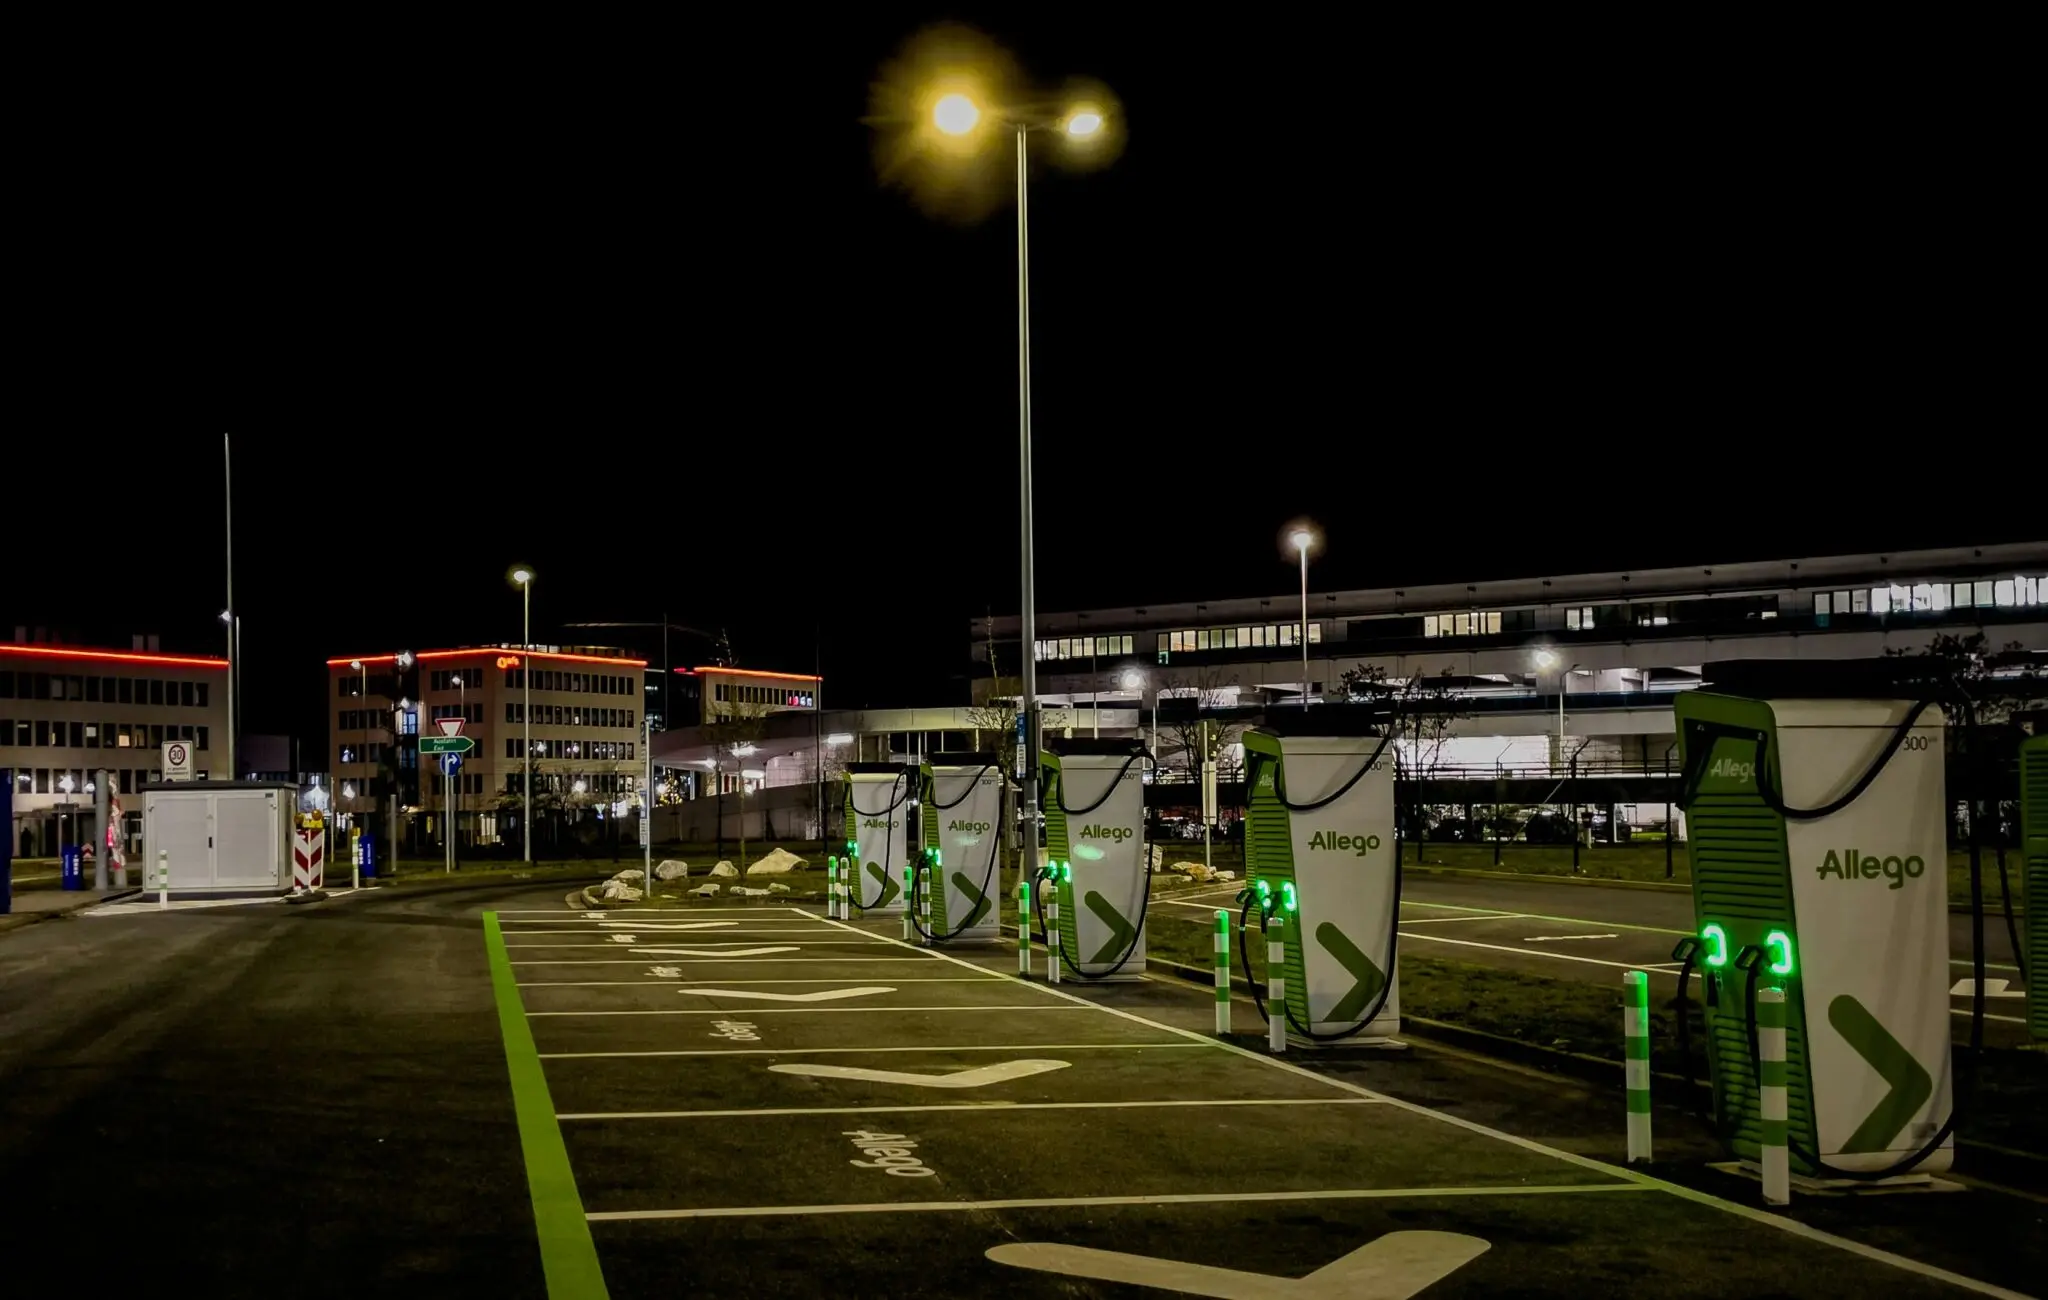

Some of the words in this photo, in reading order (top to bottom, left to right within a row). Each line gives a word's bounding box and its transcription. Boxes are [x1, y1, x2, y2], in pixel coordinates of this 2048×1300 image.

[171, 750, 183, 760] 30
[947, 819, 991, 835] Allego
[1079, 824, 1134, 844] Allego
[1307, 830, 1381, 857] Allego
[1815, 849, 1925, 890] Allego
[841, 1130, 936, 1177] Allego
